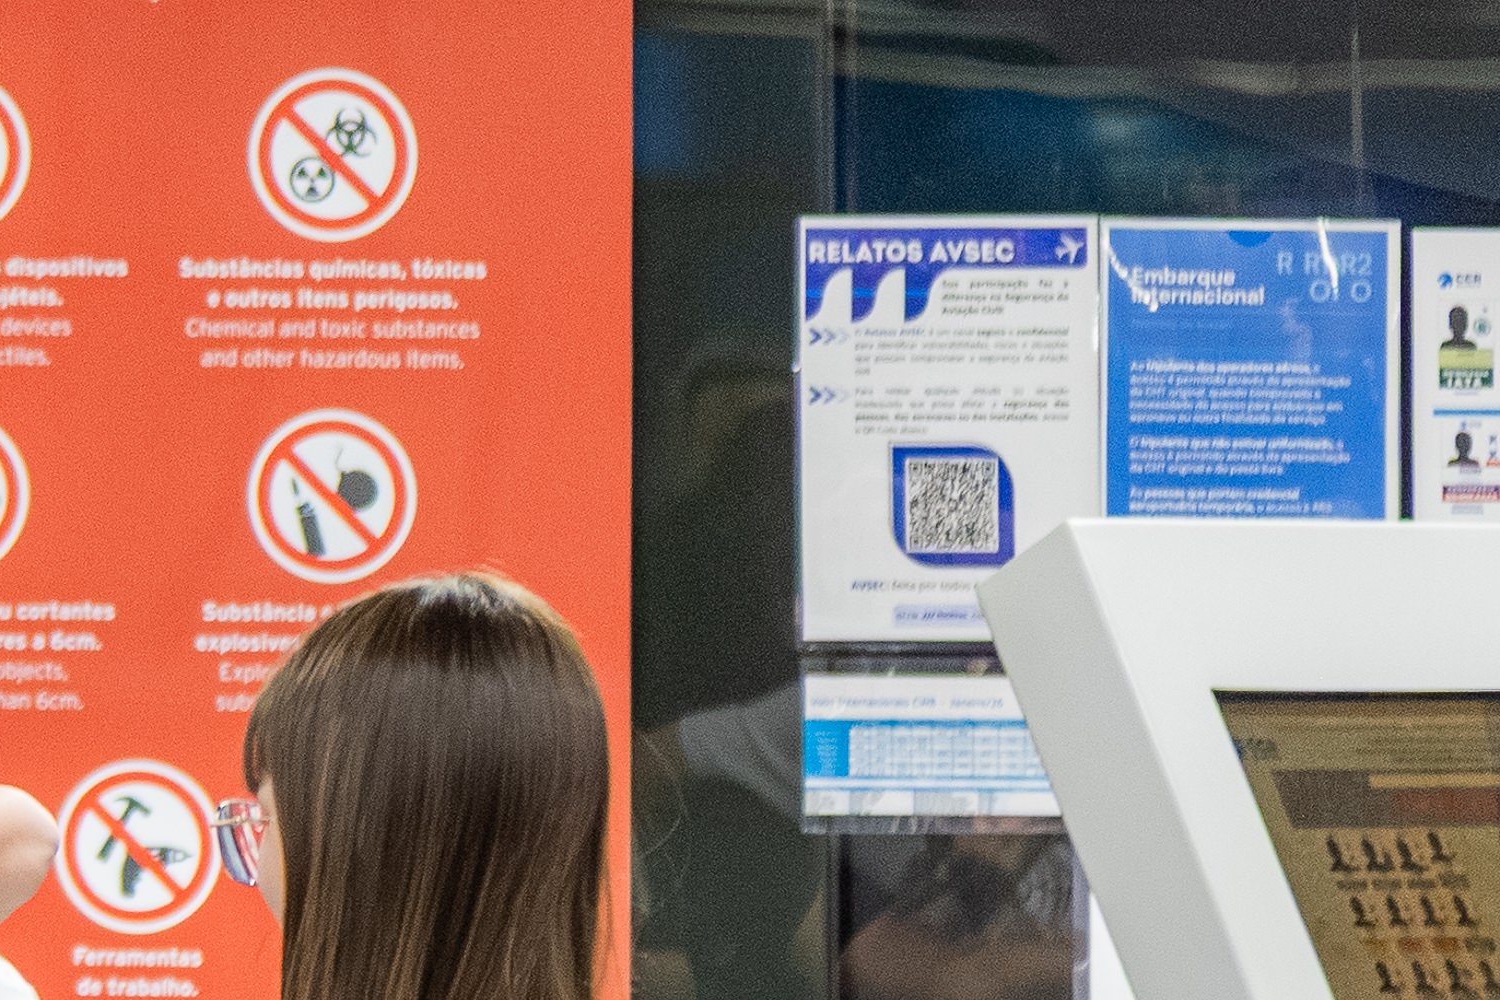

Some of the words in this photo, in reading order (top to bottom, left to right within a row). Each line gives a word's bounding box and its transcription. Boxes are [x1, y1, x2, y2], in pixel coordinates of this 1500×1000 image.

[809, 238, 924, 264] RELATOS
[929, 240, 1016, 264] AVSEC
[4, 256, 130, 279] dispositivos
[178, 255, 305, 279] Substâncias
[309, 257, 407, 281] químicas,
[411, 257, 488, 280] tóxicas
[1130, 267, 1236, 289] Embarque
[206, 291, 220, 309] e
[224, 289, 292, 309] outros
[297, 288, 349, 310] itens
[353, 289, 459, 312] perigosos.
[1131, 285, 1265, 306] Internacional
[0, 316, 73, 338] devices
[184, 318, 275, 340] Chemical
[279, 319, 316, 340] and
[320, 319, 368, 341] toxic
[372, 319, 481, 341] substances
[200, 348, 238, 369] and
[241, 348, 296, 369] other
[300, 349, 402, 371] hazardous
[405, 349, 466, 371] items.
[16, 602, 116, 622] cortantes
[202, 600, 316, 623] Substância
[32, 635, 46, 651] a
[50, 632, 103, 652] 6cm.
[35, 691, 84, 711] 6cm.
[72, 946, 203, 968] Ferramentas
[76, 978, 101, 997] de
[107, 978, 200, 998] trabalho.
